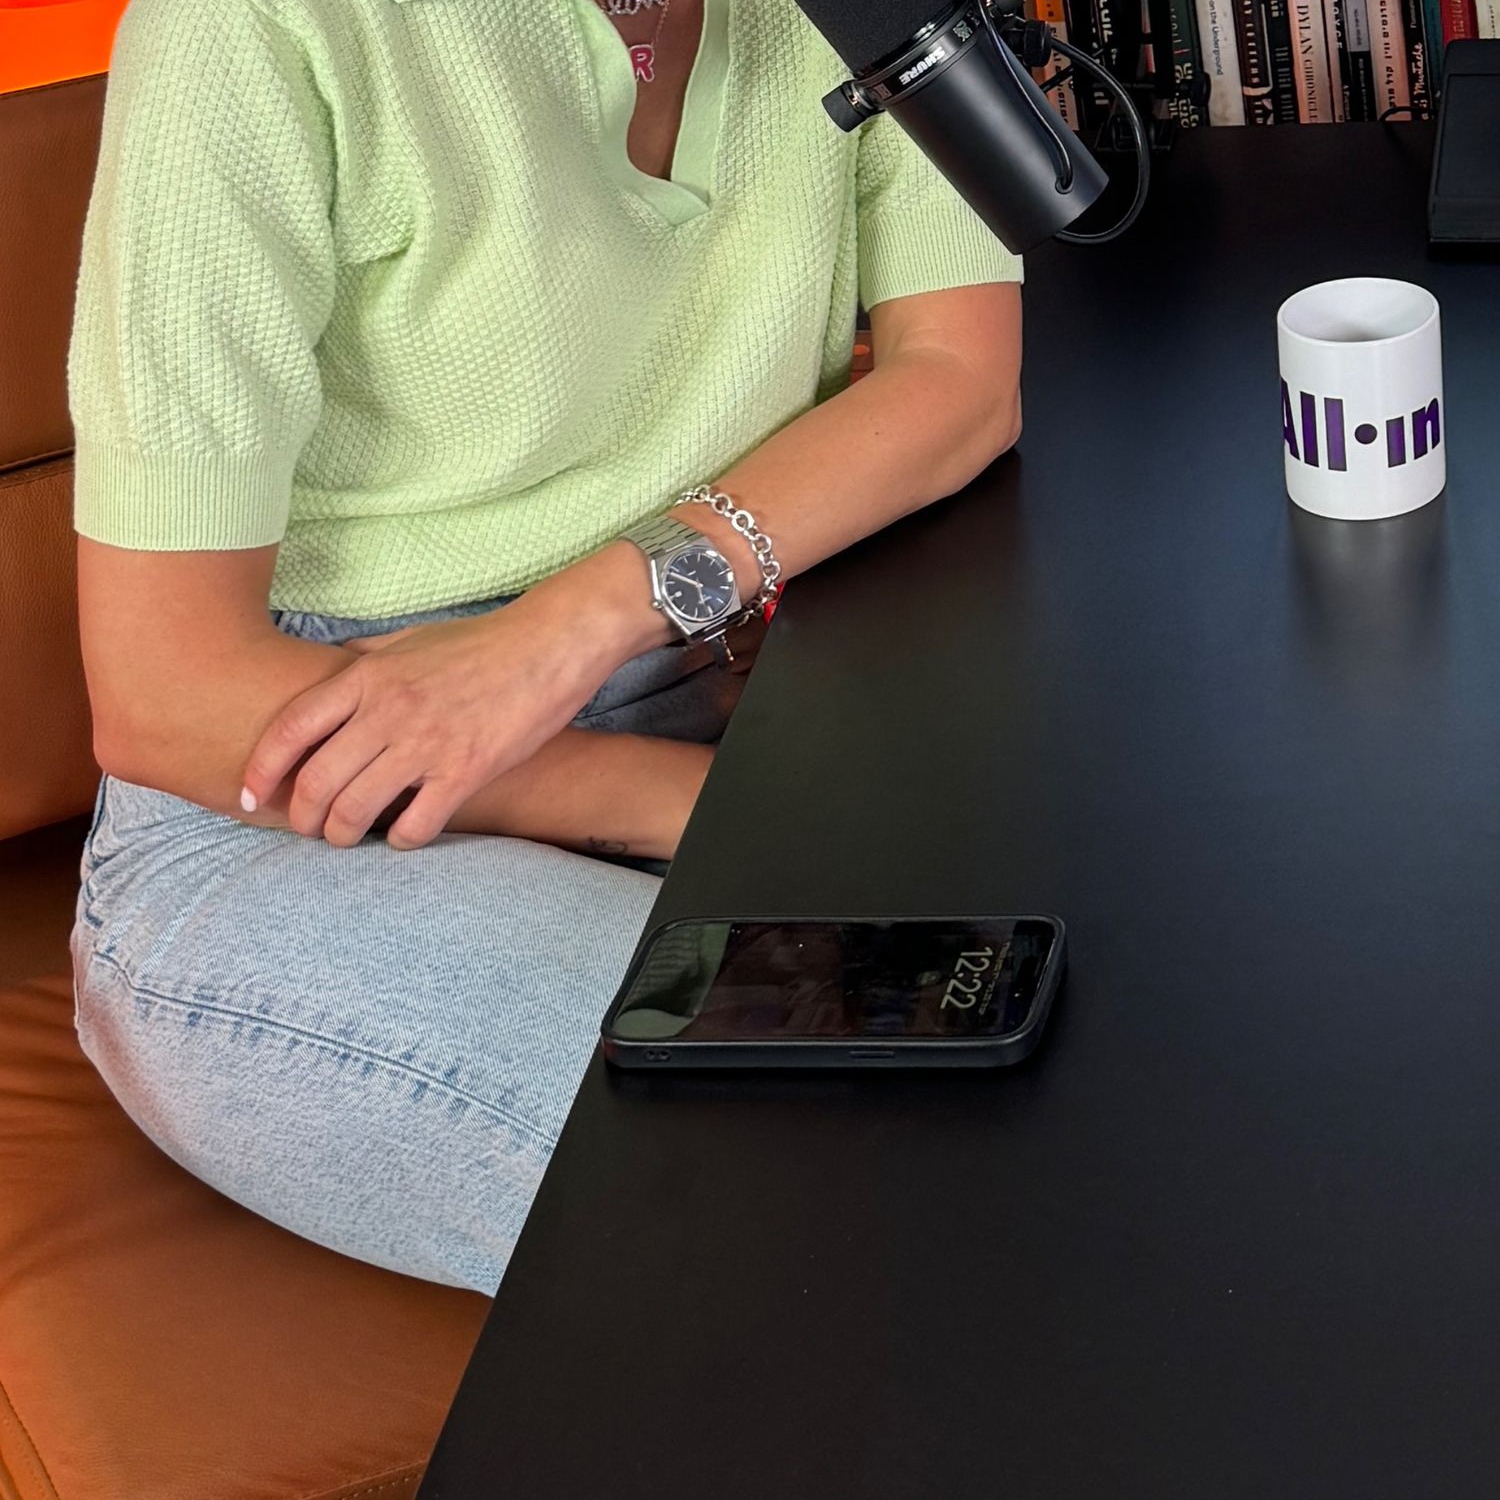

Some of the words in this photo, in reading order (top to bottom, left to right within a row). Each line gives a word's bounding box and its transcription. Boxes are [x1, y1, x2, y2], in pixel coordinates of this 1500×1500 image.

[1211, 26, 1224, 76] Underground
[1246, 23, 1260, 84] LETTERS
[1297, 5, 1314, 55] DYLAN
[629, 45, 655, 83] R
[899, 46, 945, 85] SHURE
[1304, 59, 1318, 120] CHRONICLE
[941, 946, 994, 1012] 12:22
